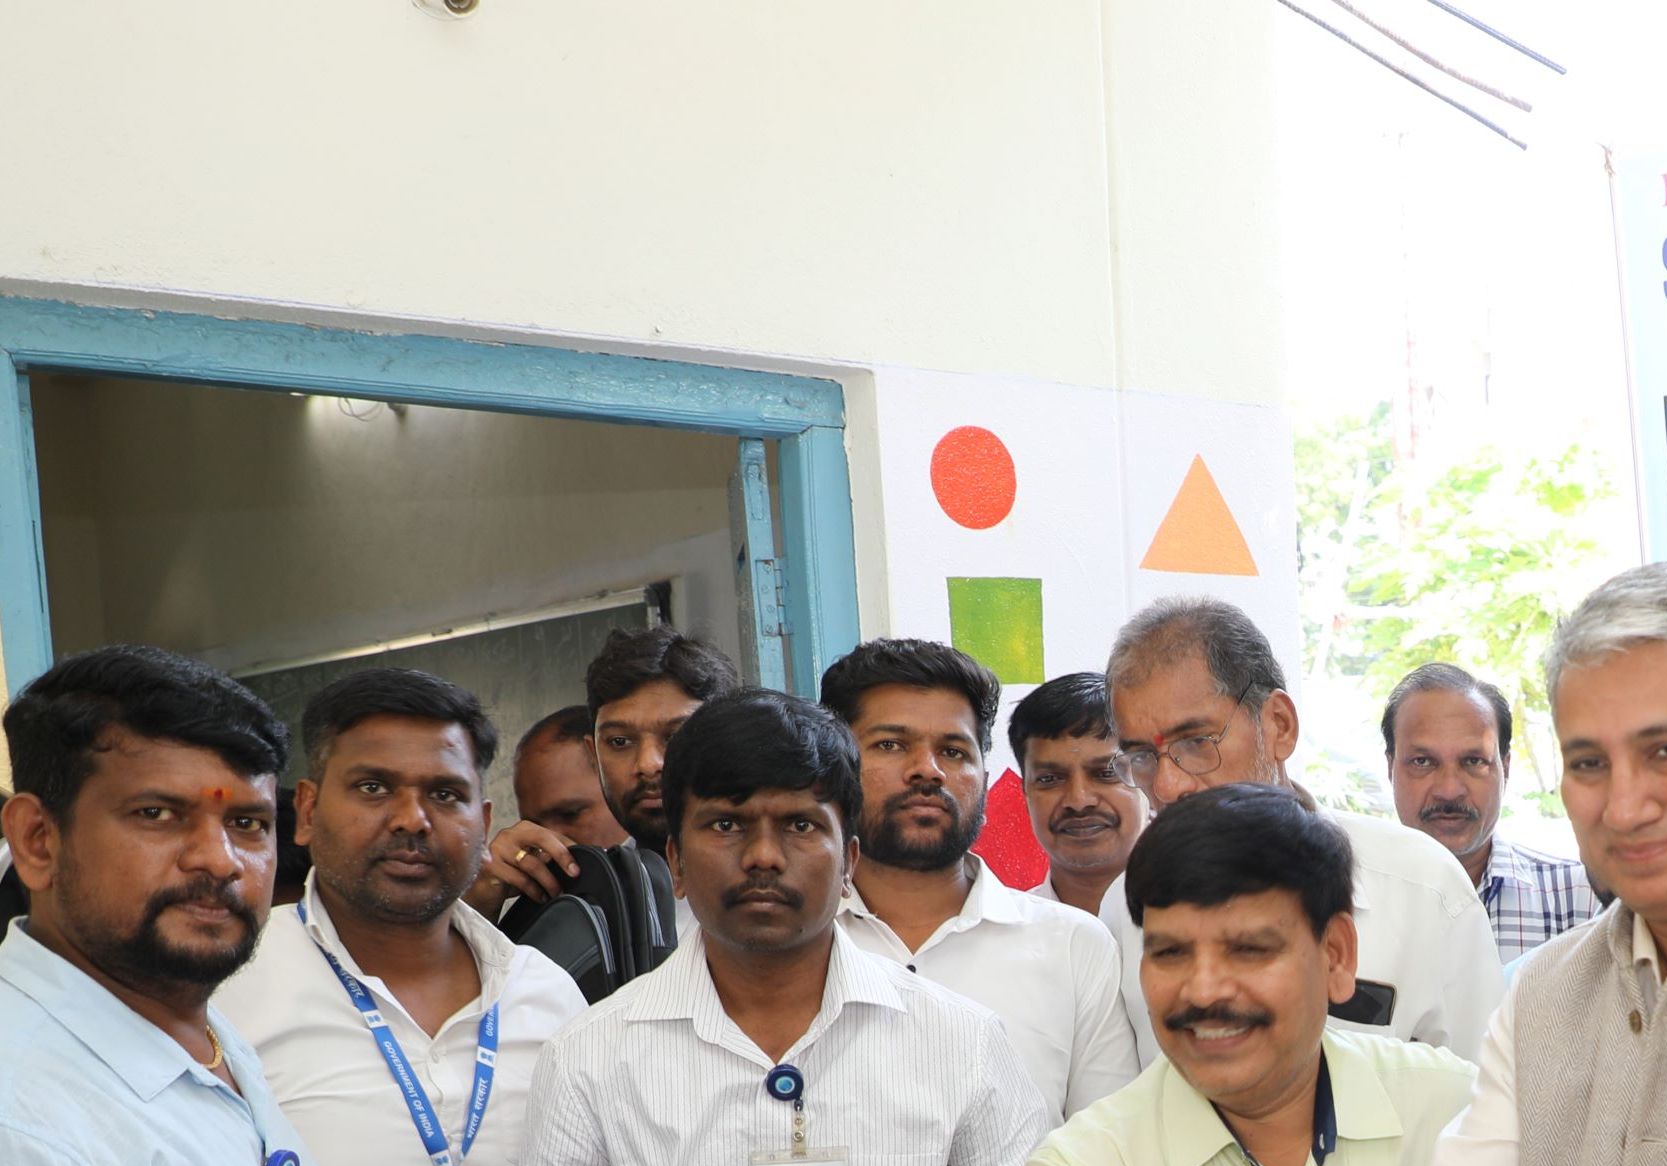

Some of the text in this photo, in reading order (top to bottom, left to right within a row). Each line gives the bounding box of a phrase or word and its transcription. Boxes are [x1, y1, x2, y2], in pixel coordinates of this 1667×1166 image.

[383, 1041, 435, 1138] GOVERNMENT OF INDIA
